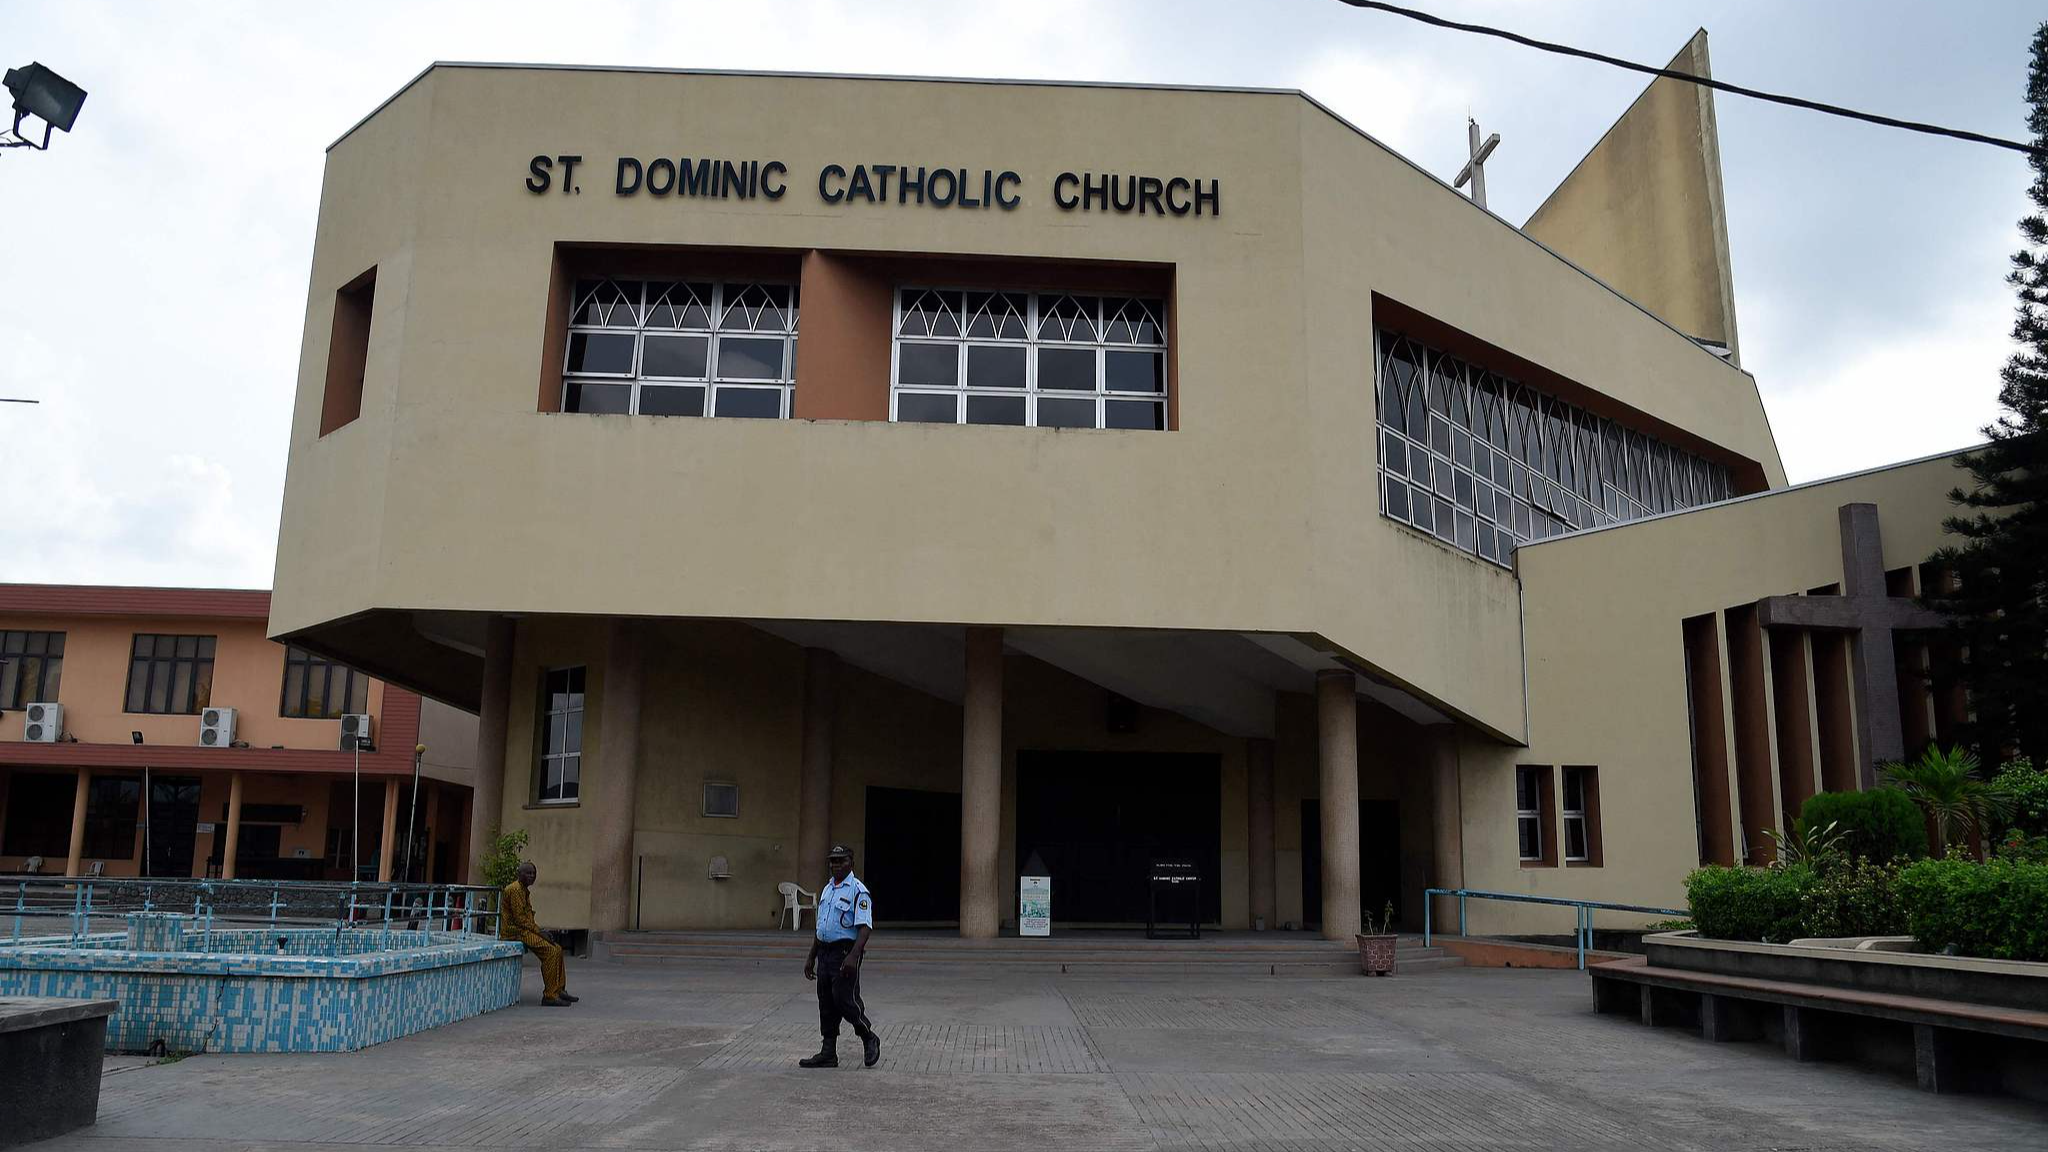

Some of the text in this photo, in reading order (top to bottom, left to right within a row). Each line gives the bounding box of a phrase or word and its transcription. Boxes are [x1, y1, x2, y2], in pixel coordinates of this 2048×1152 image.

[526, 155, 1220, 217] ST. DOMINIC CATHOLIC CHURCH
